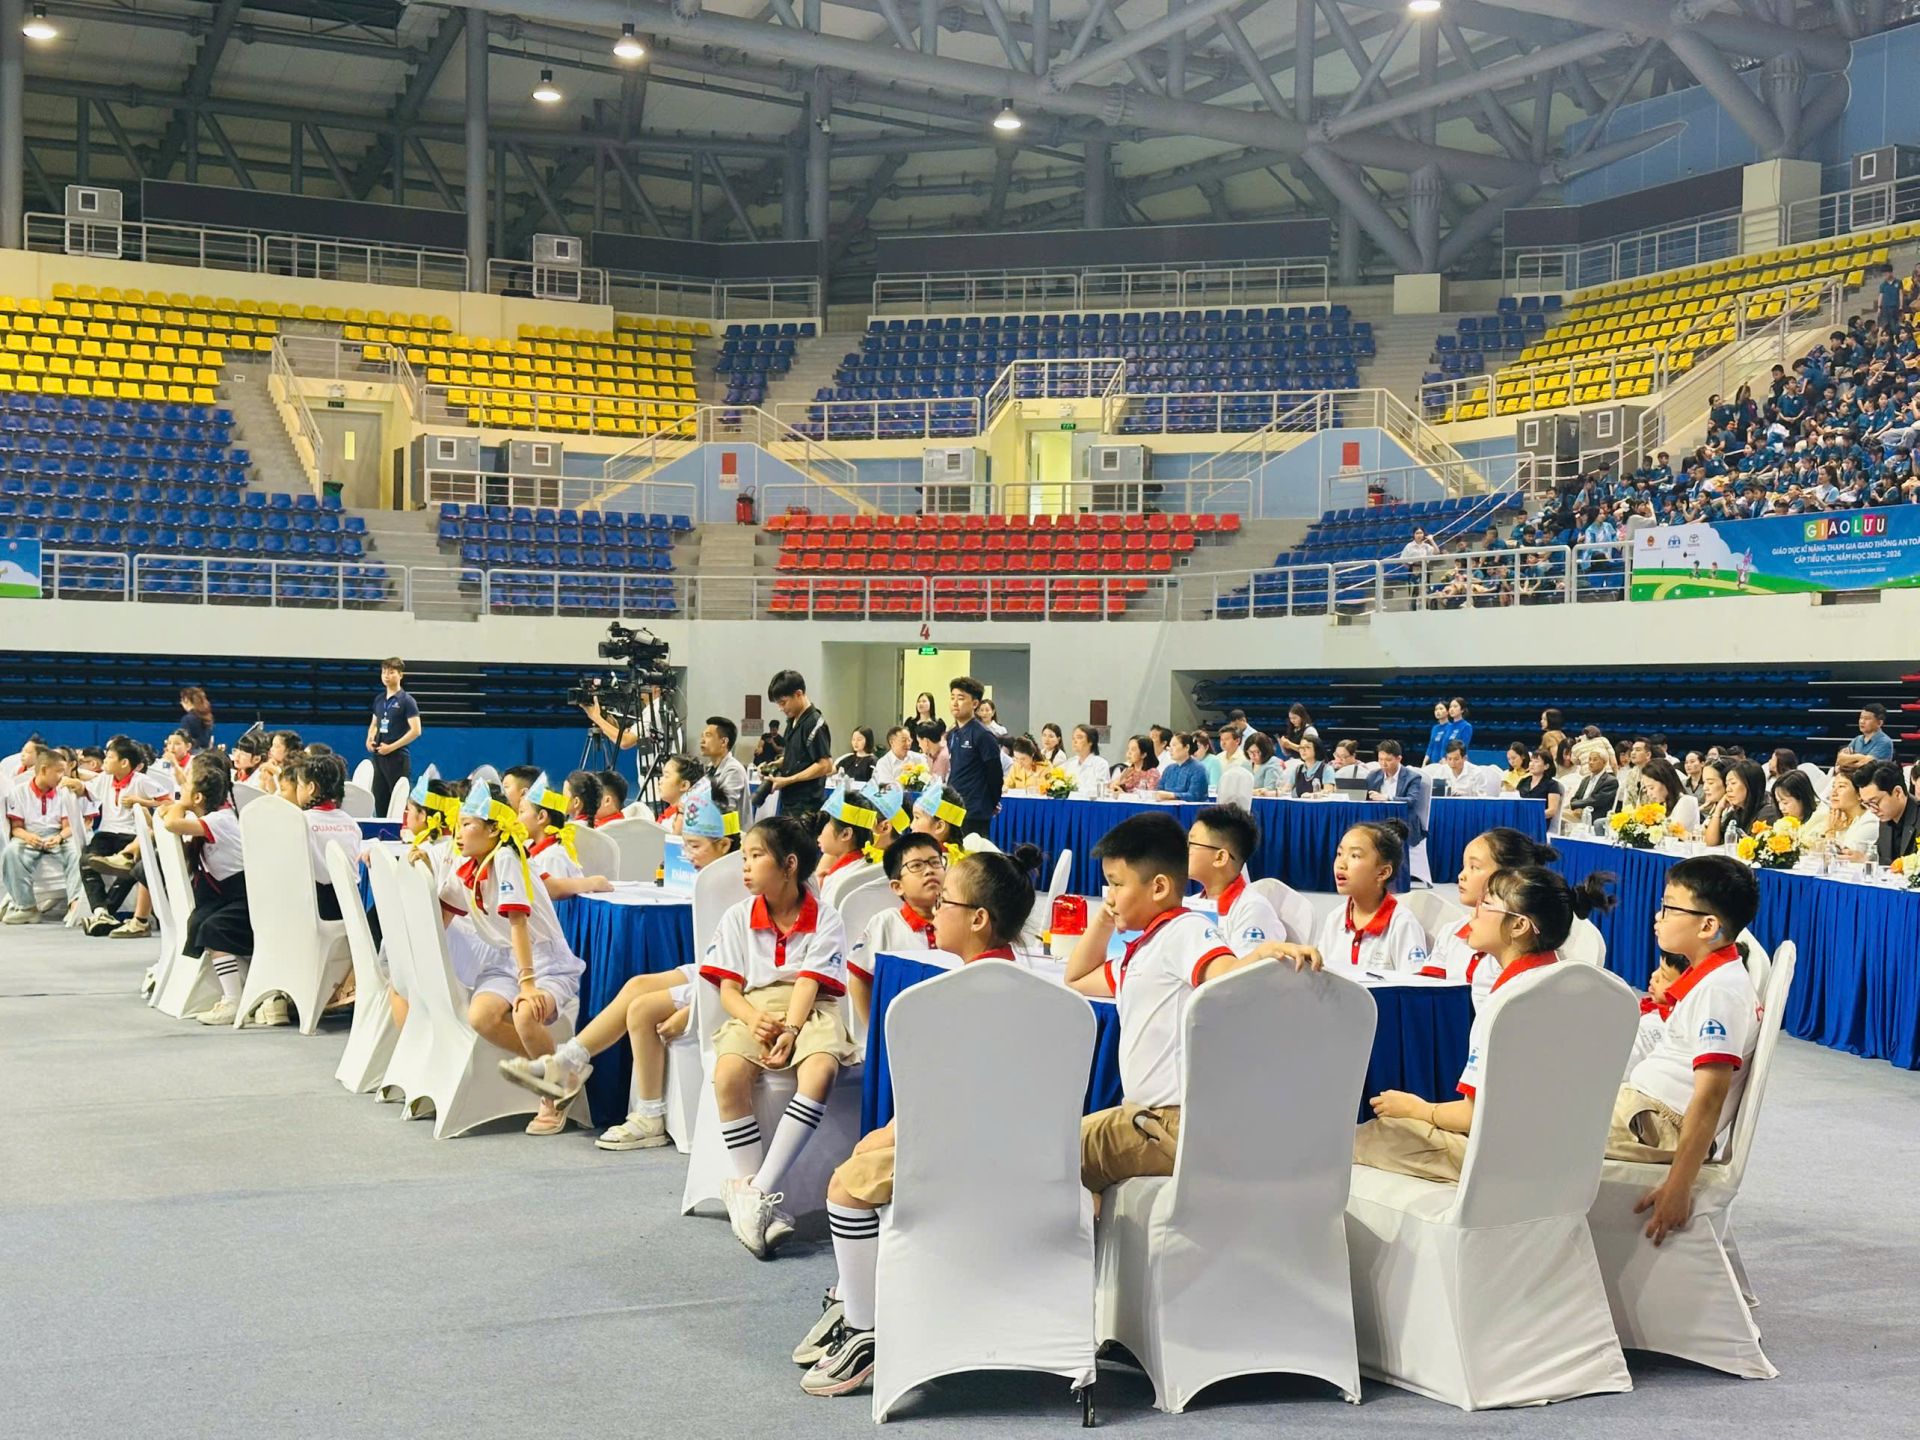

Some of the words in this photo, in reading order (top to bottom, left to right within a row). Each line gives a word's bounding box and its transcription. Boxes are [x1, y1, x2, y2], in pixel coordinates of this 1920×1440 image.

[1806, 520, 1851, 538] GIAO
[1853, 518, 1885, 534] LƯU
[1827, 543, 1845, 551] THAM
[1845, 542, 1857, 550] GIA
[1857, 541, 1874, 549] GIAO
[1875, 538, 1897, 549] THÔNG
[920, 624, 930, 640] 4
